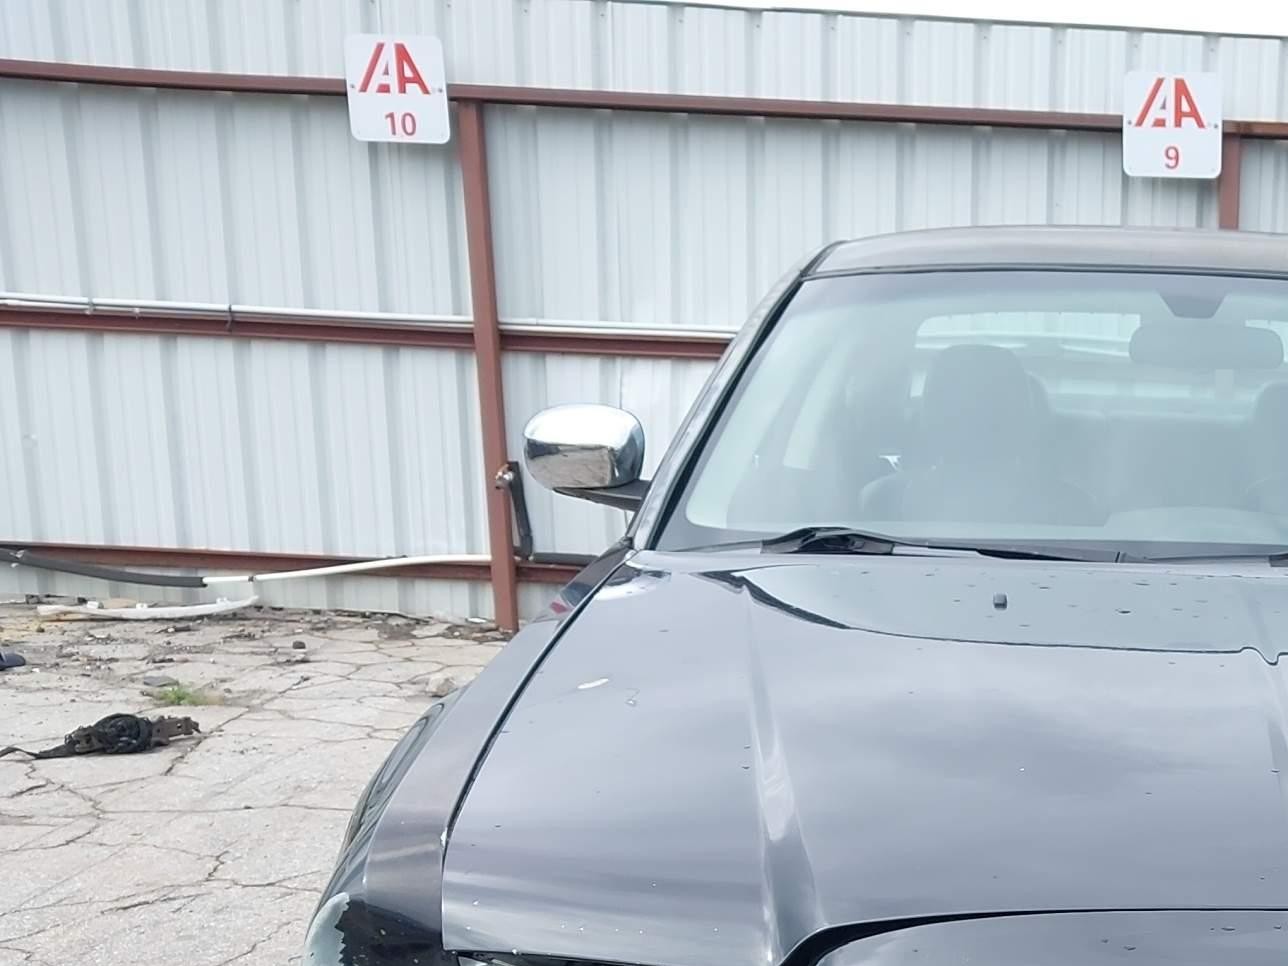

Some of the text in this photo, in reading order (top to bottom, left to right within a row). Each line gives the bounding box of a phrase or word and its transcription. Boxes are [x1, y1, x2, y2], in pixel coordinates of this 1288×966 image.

[358, 42, 431, 94] IAA
[1135, 77, 1206, 128] IAA
[384, 112, 417, 136] 10
[1164, 145, 1180, 170] 9
